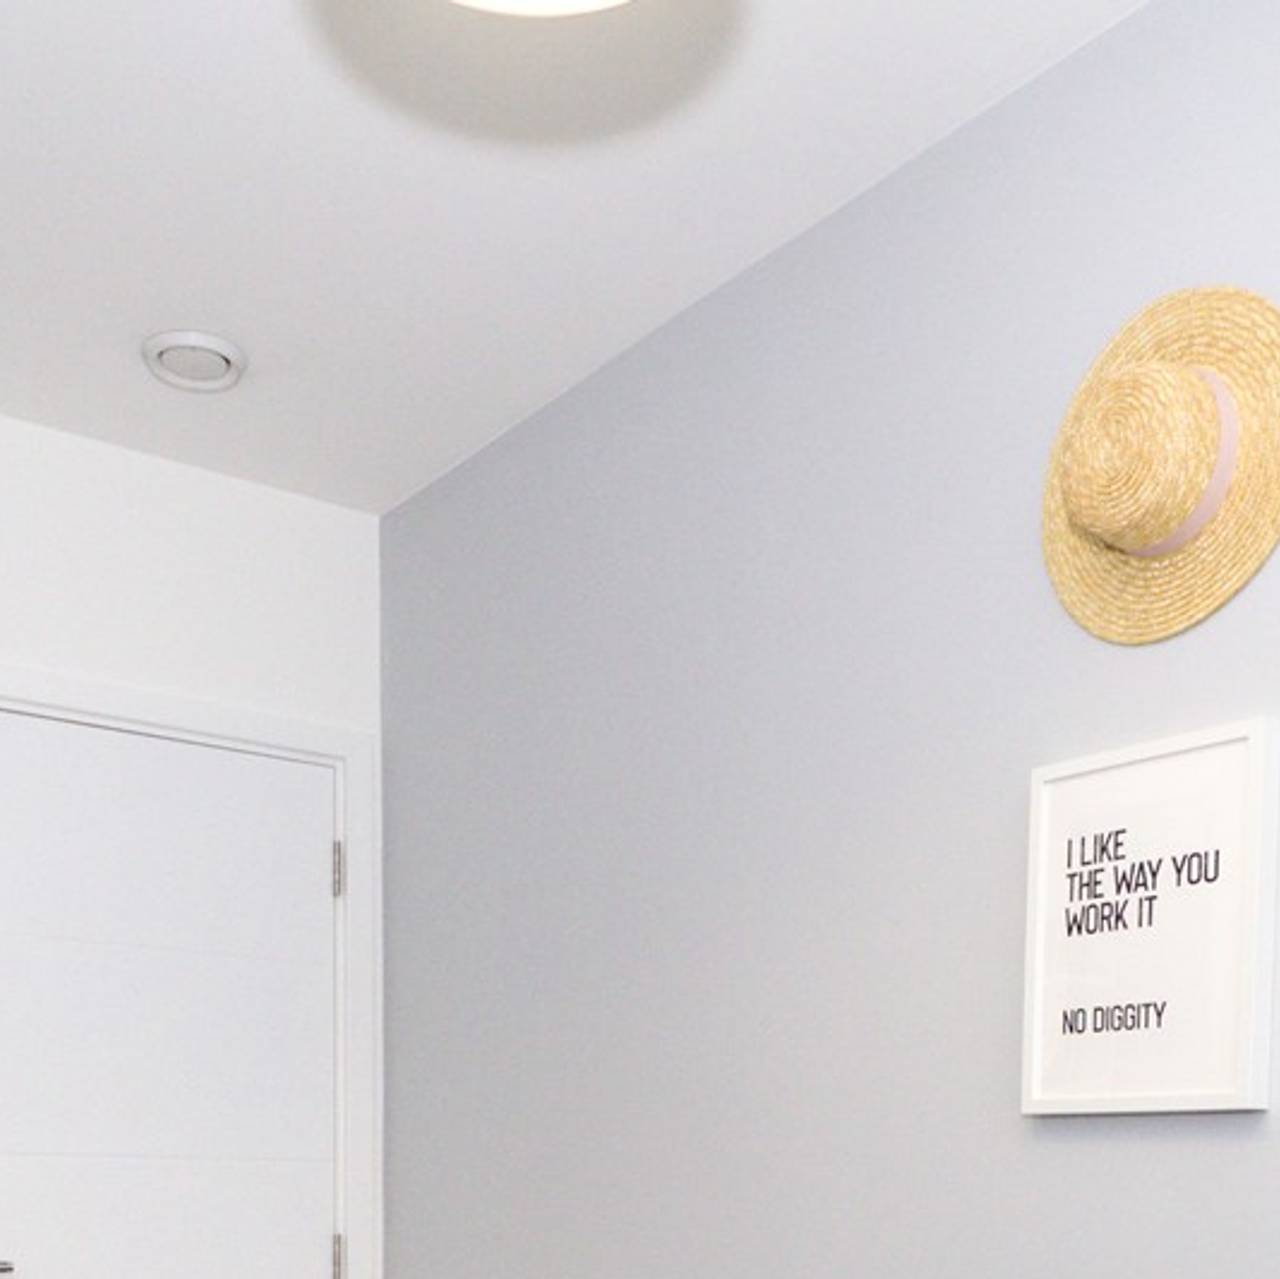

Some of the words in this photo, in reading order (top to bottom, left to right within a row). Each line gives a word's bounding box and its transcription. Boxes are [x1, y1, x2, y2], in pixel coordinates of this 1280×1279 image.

[1067, 838, 1073, 869] I
[1080, 828, 1127, 867] LIKE
[1066, 868, 1105, 902] THE
[1113, 857, 1163, 895] WAY
[1172, 849, 1220, 887] YOU
[1065, 899, 1129, 937] WORK
[1137, 895, 1158, 928] IT
[1062, 1007, 1087, 1035] NO
[1094, 1001, 1167, 1033] DIGGITY
